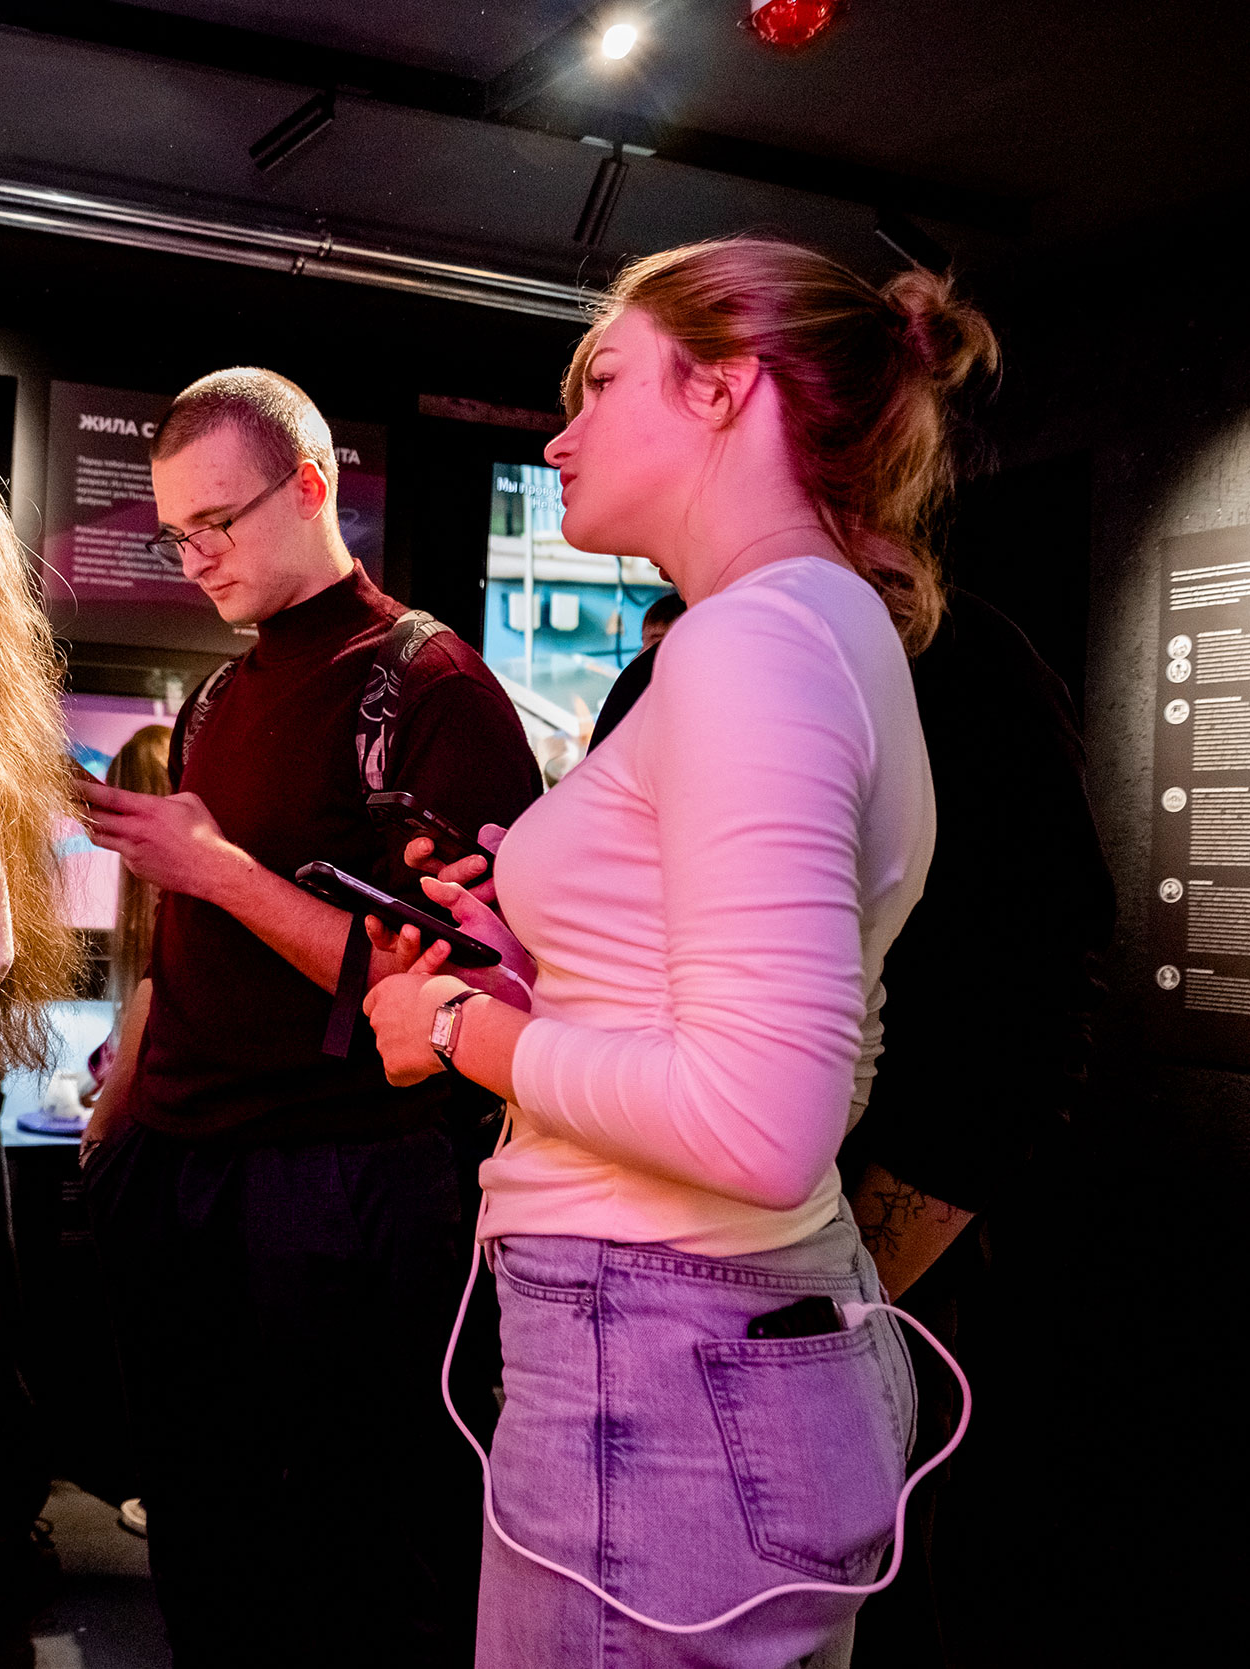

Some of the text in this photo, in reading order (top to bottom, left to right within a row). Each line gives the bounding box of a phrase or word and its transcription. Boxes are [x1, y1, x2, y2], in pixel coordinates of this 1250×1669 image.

[78, 413, 138, 436] ЖИЛА
[141, 422, 159, 439] С
[496, 476, 518, 494] Мы
